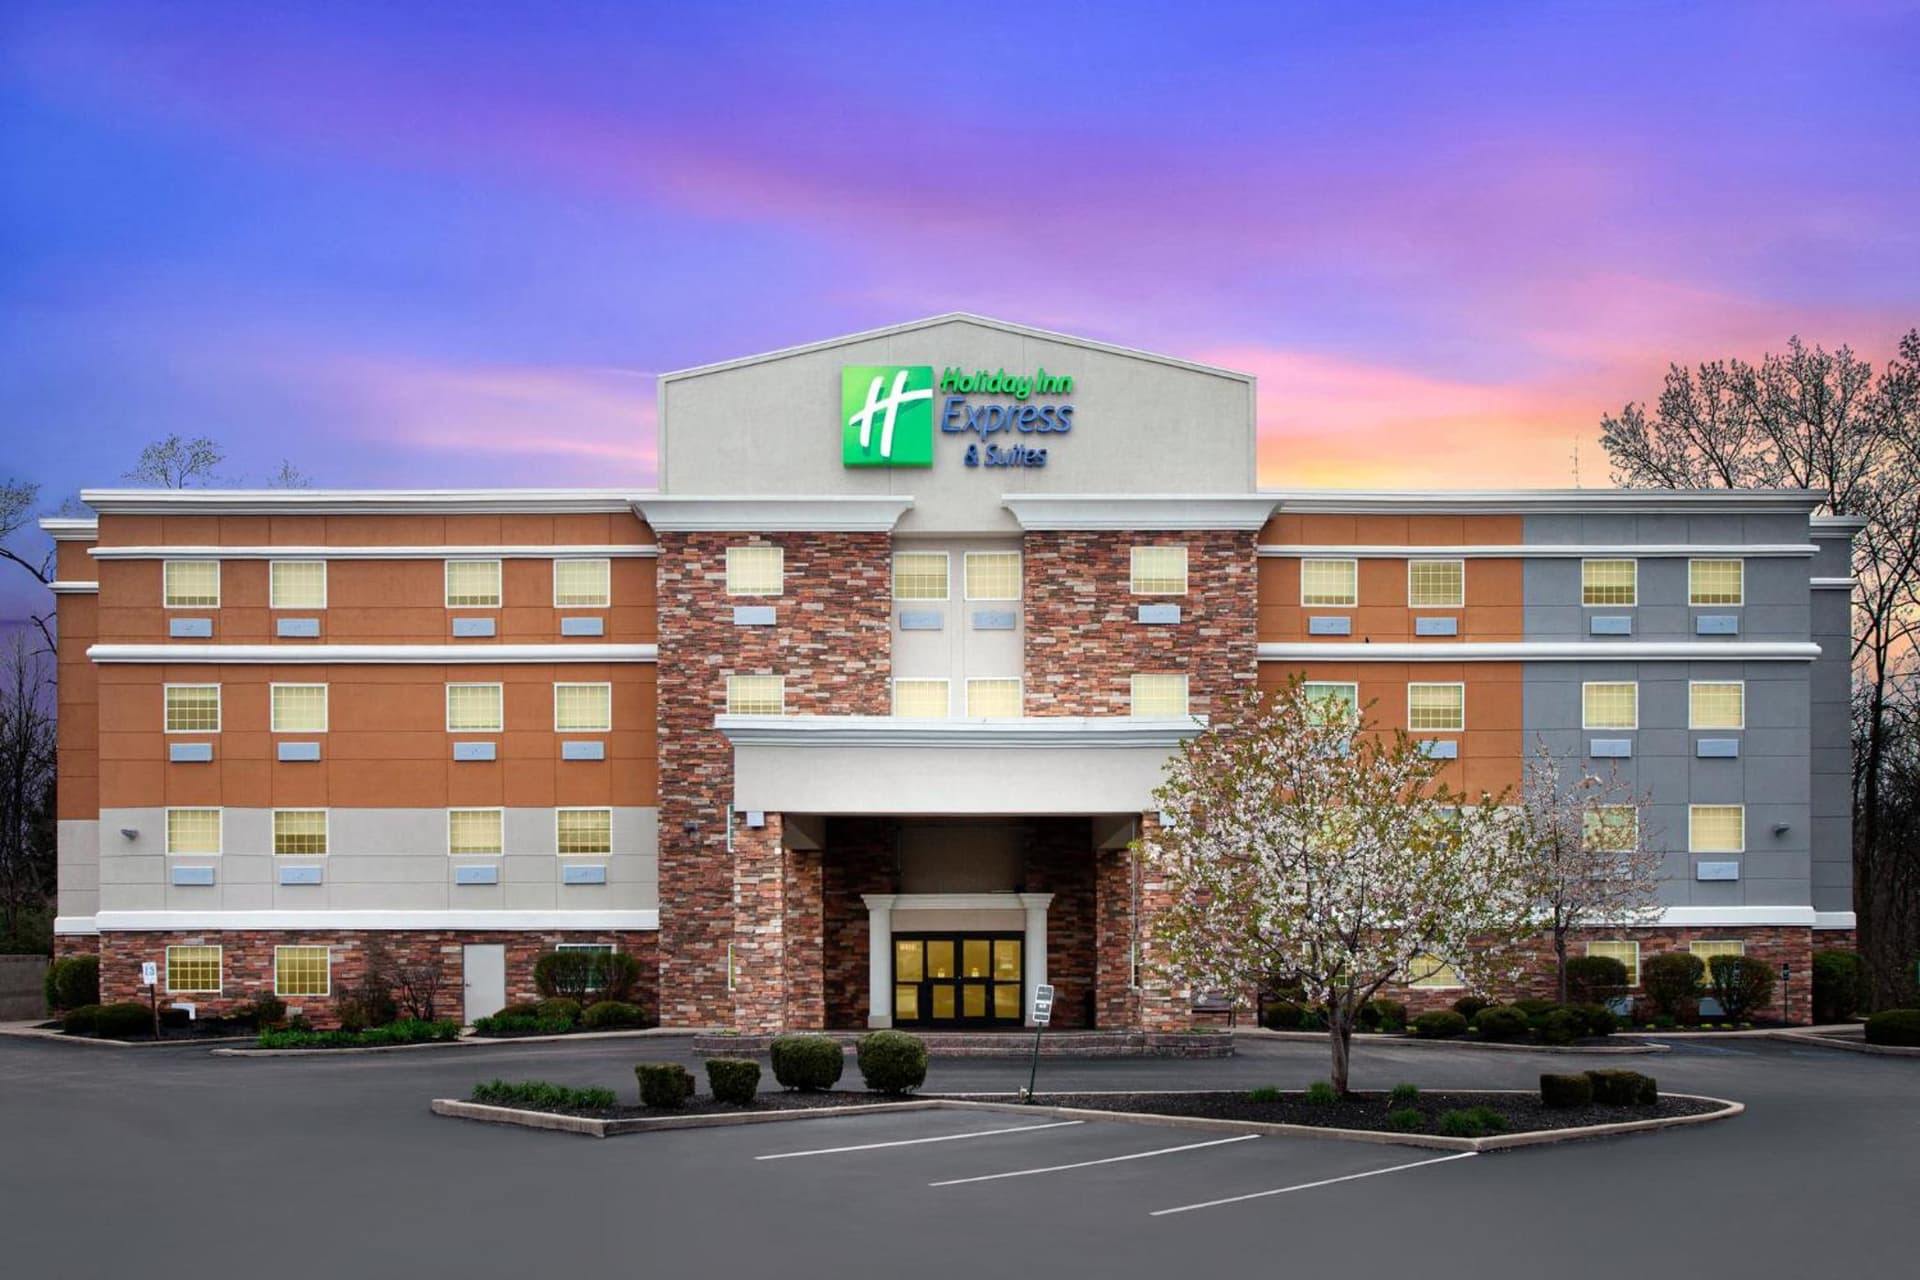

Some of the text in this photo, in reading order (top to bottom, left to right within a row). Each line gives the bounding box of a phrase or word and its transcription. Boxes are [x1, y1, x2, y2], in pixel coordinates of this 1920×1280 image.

[941, 367, 1072, 400] Holiday Inn
[942, 396, 1074, 441] Express
[964, 443, 1047, 468] & Suites
